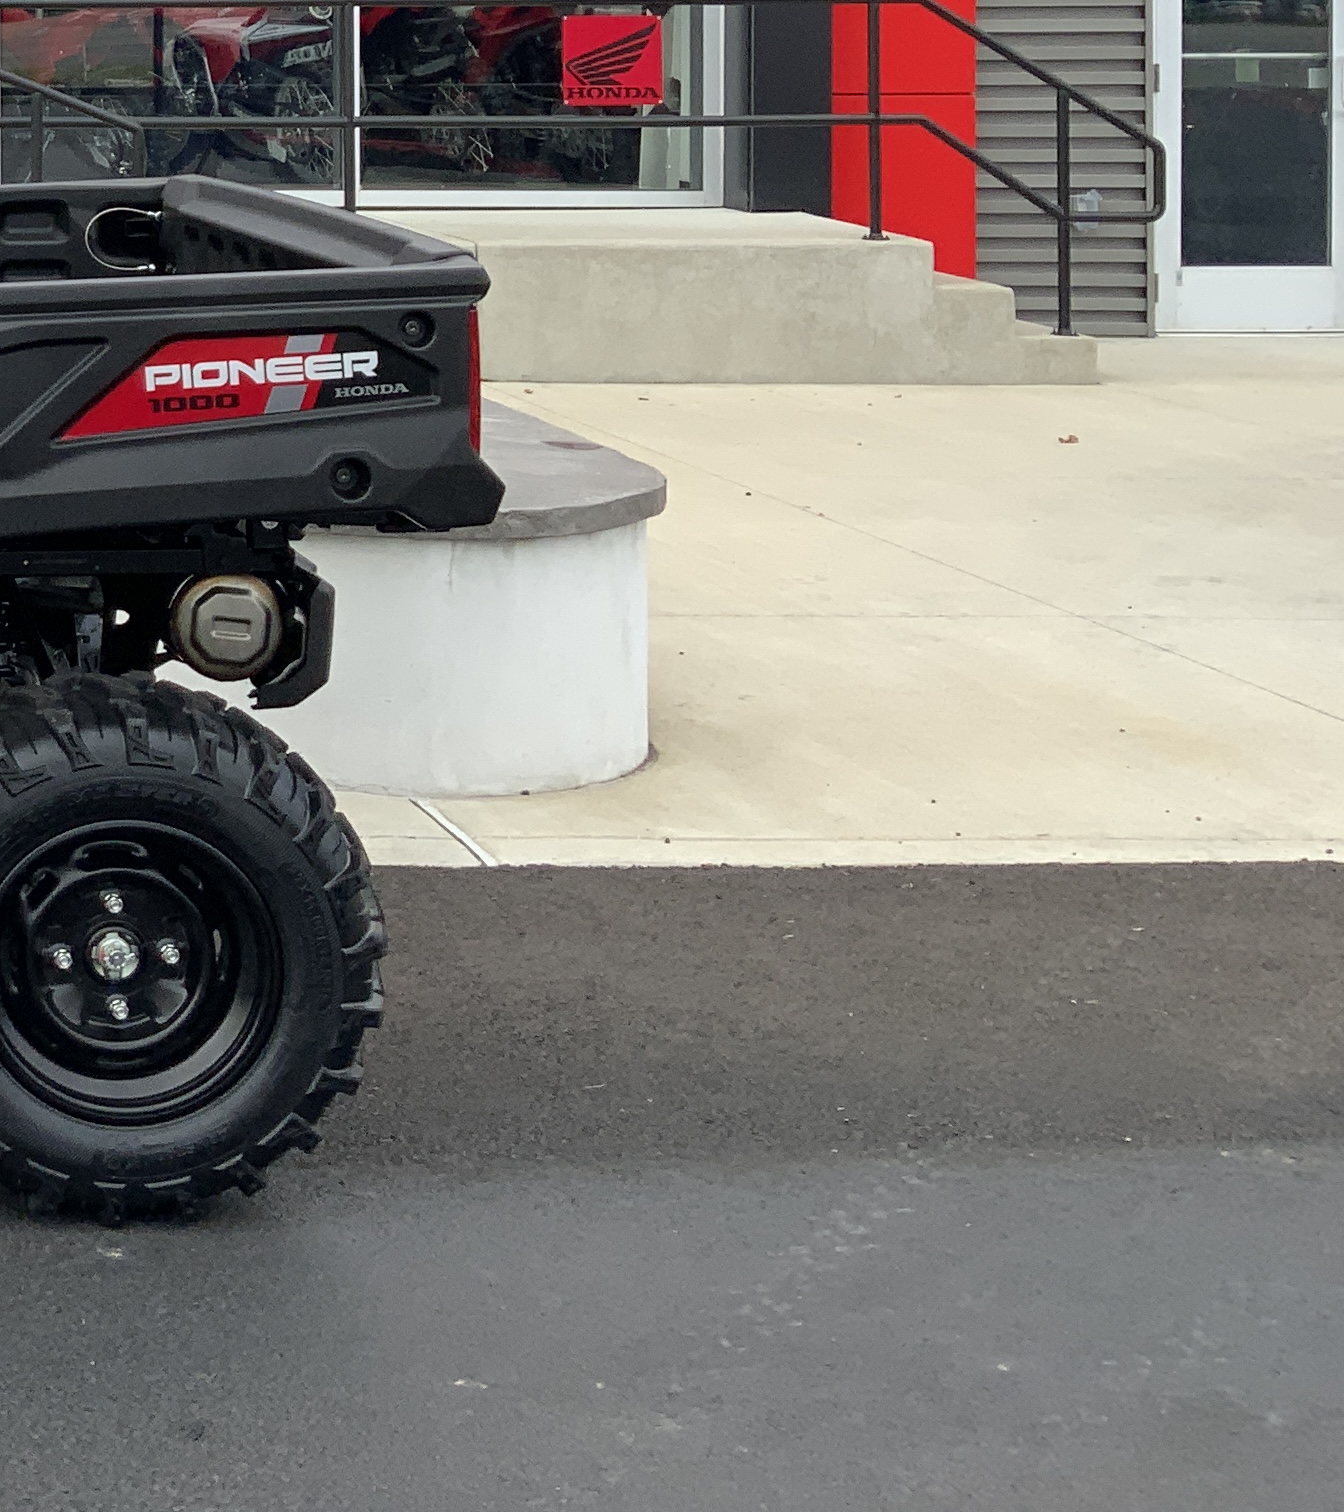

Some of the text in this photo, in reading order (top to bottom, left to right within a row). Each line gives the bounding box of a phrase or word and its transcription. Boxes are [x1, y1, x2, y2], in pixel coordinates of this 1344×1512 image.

[567, 87, 661, 99] HONDA
[144, 351, 379, 392] PIONEER
[334, 383, 410, 399] HONDA
[148, 393, 240, 413] 1000
